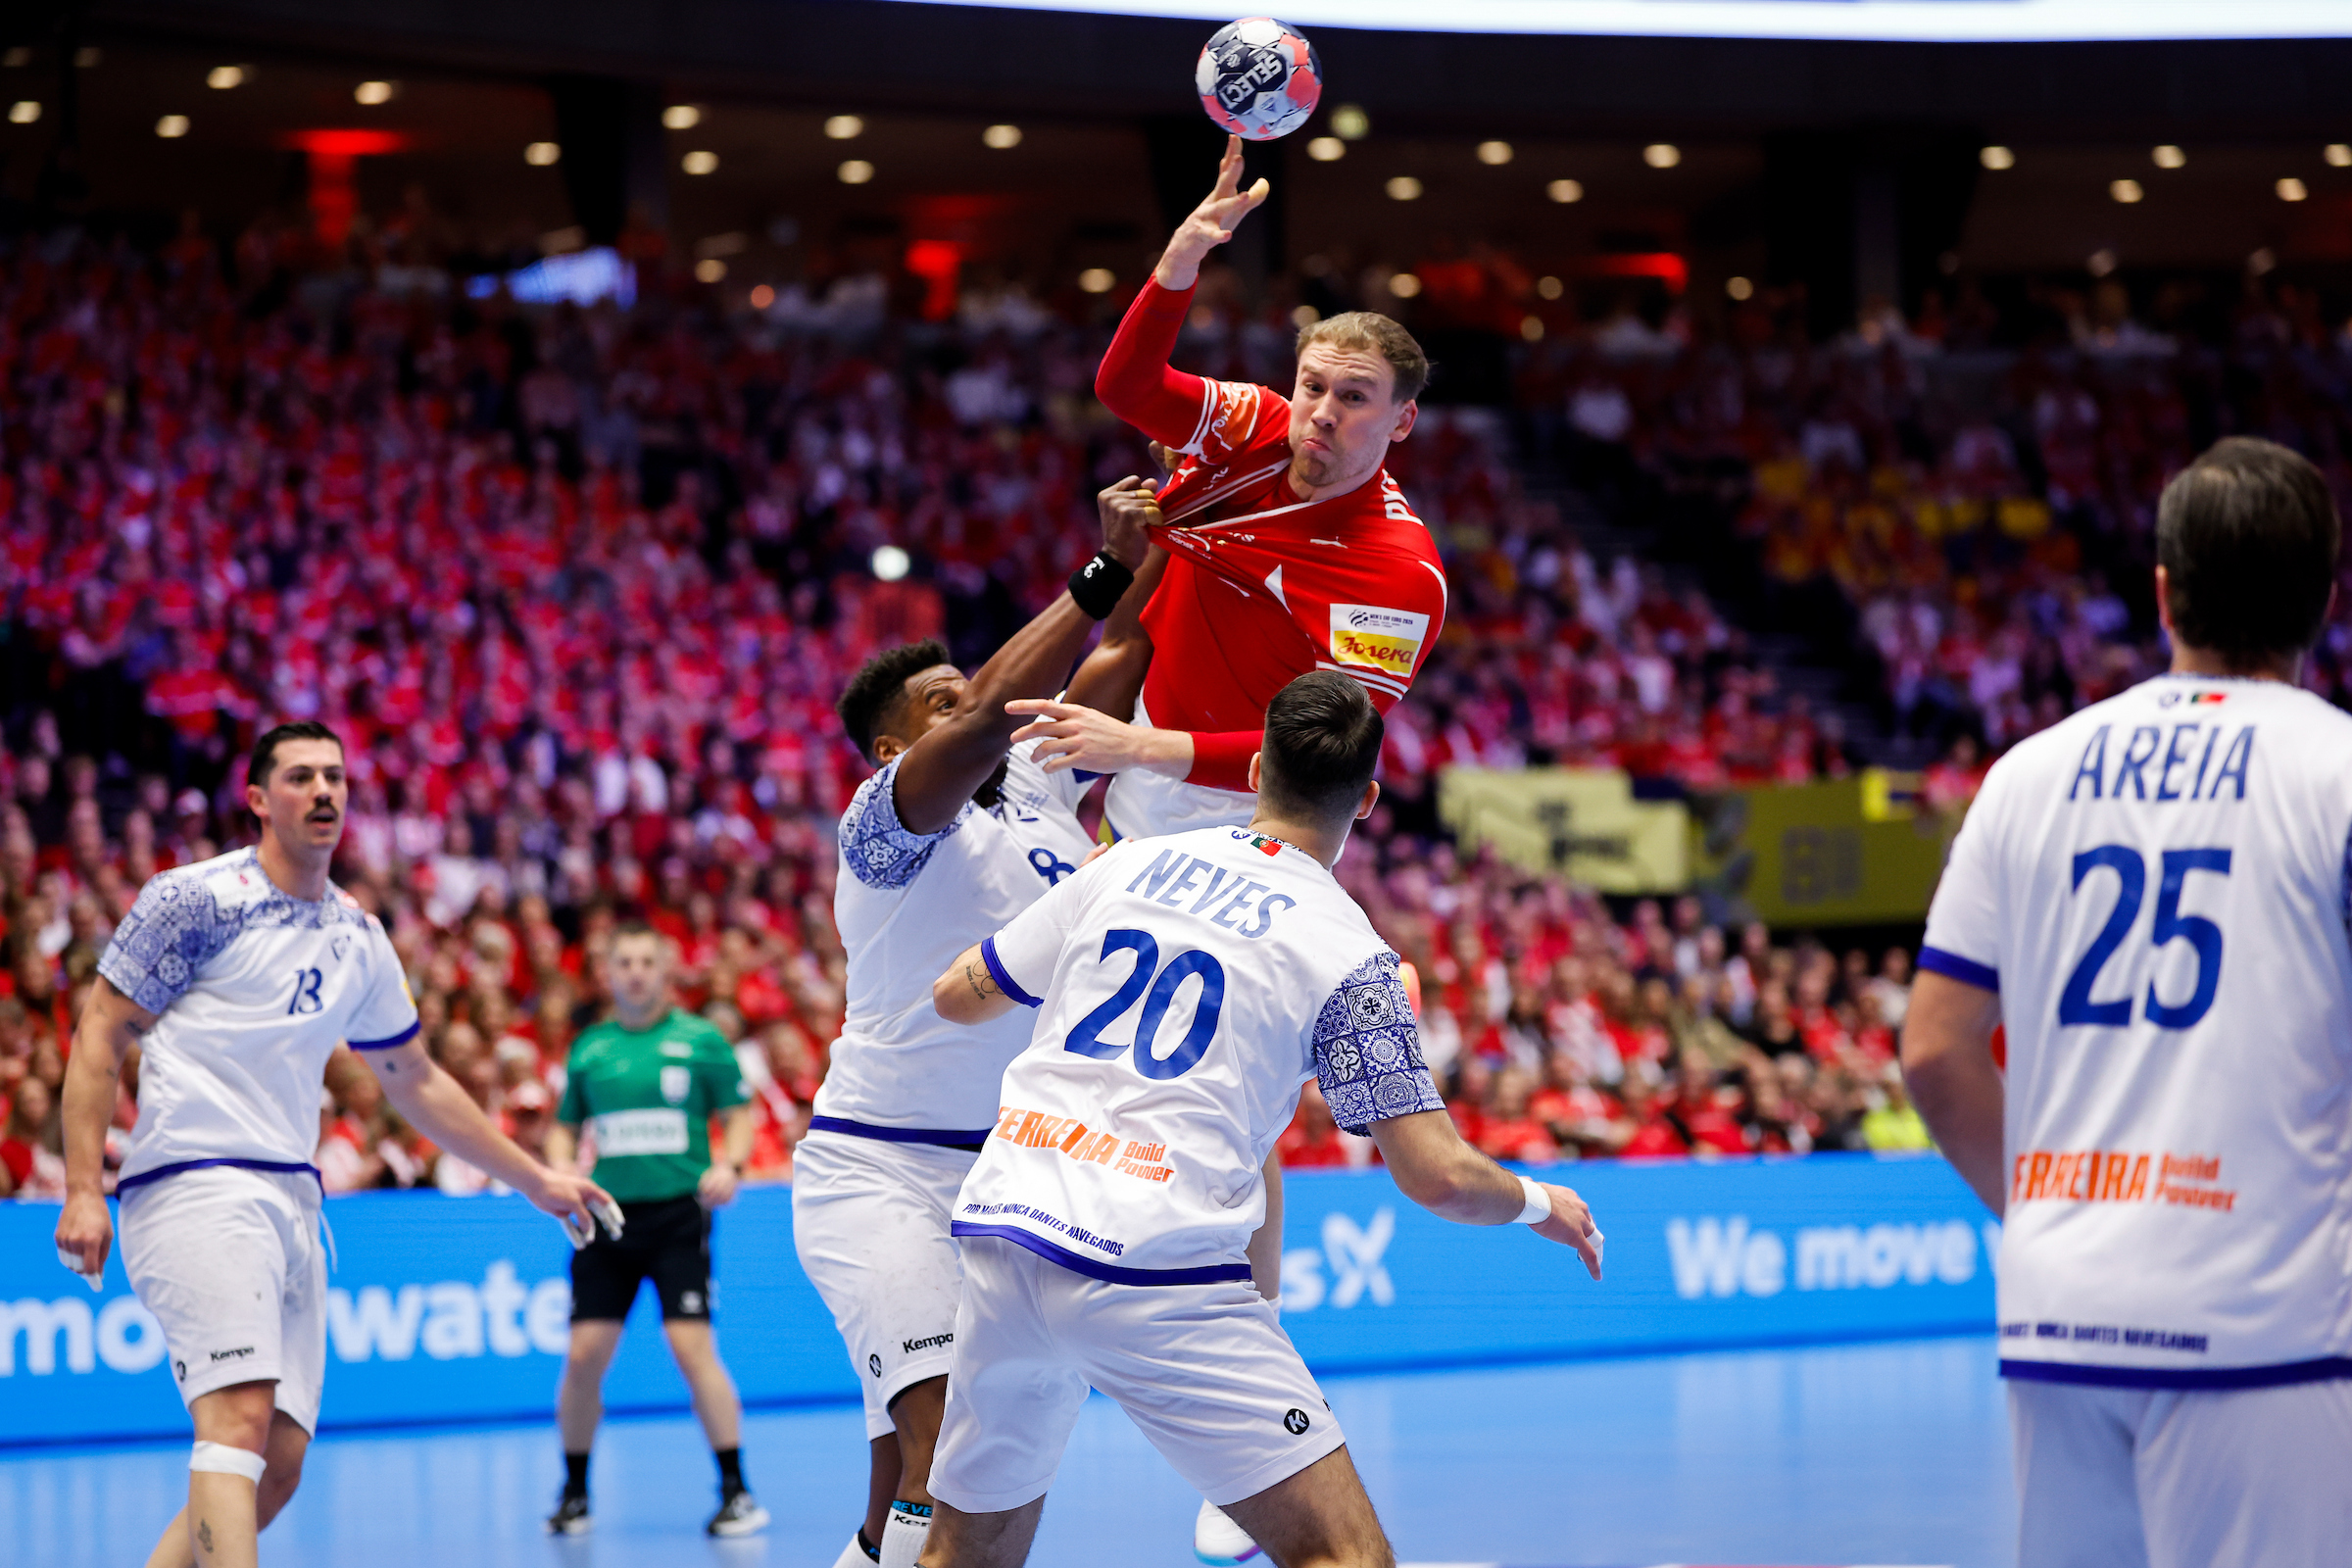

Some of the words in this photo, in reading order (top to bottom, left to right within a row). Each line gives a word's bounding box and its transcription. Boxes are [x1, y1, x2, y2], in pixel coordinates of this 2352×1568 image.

[1218, 53, 1283, 110] SELECT
[1338, 637, 1414, 663] Josera
[2069, 723, 2258, 802] AREIA
[1125, 848, 1296, 939] NEVES
[2059, 844, 2232, 1029] 25
[288, 967, 322, 1015] 13
[1063, 929, 1225, 1081] 20
[1113, 1157, 1175, 1183] Power
[1123, 1141, 1166, 1162] Build
[1001, 1203, 1031, 1216] NUNCA
[1029, 1207, 1067, 1233] DANTES
[1065, 1226, 1124, 1256] NAVEGADOS
[1668, 1216, 1787, 1298] We
[1795, 1220, 1978, 1291] move
[903, 1333, 954, 1353] Kempa
